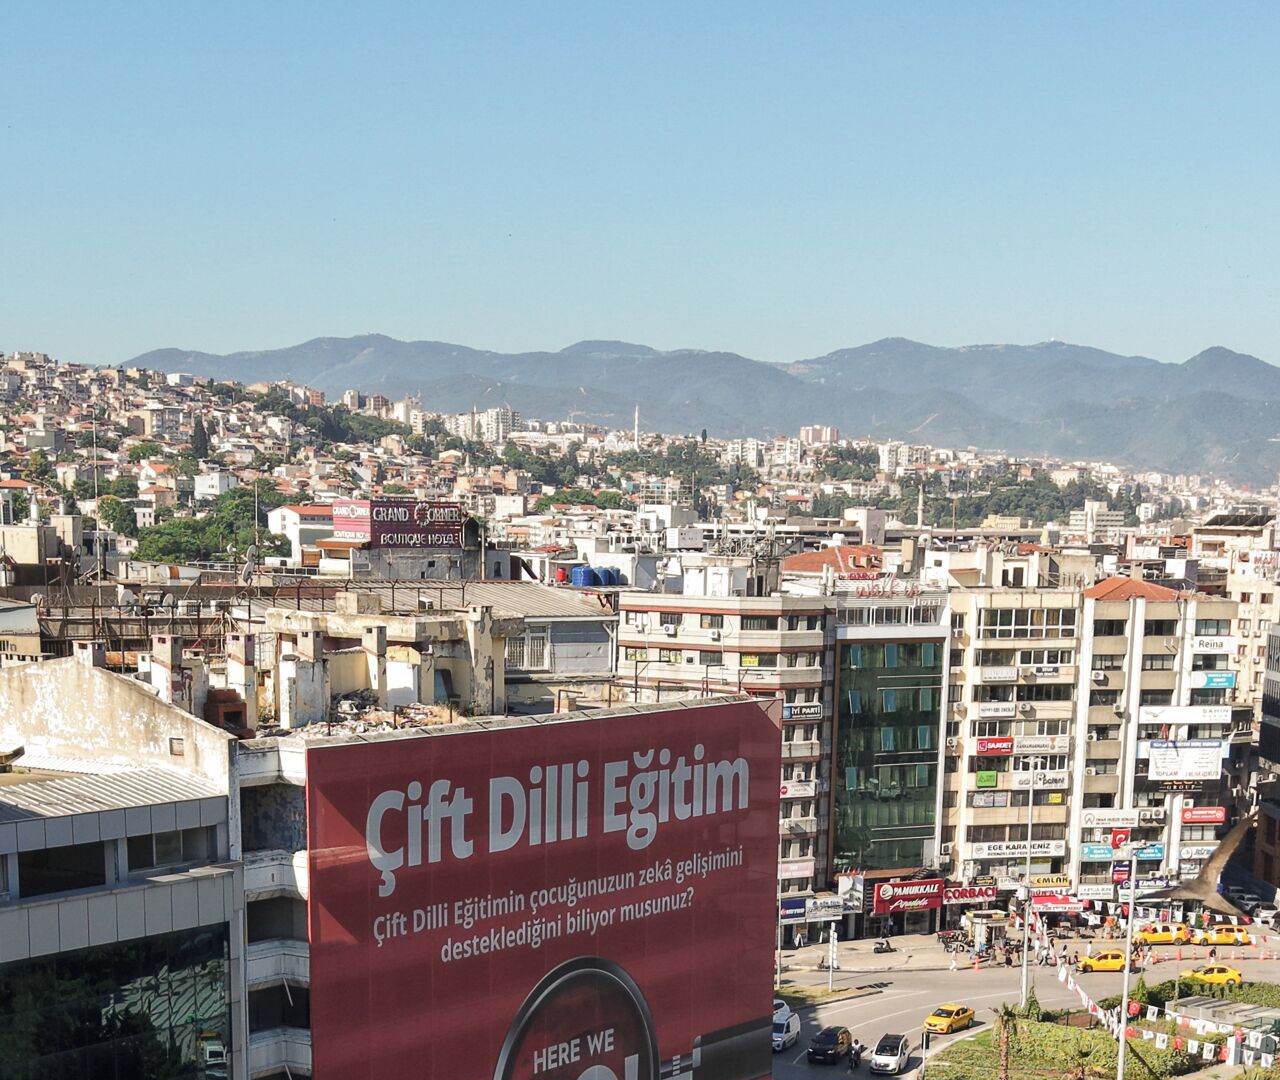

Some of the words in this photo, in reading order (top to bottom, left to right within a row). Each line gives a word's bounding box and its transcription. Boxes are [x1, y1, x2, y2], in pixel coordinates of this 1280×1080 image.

[373, 507, 409, 521] GRAND
[381, 533, 426, 546] BOUTIQUE
[1198, 639, 1224, 649] Reina
[791, 704, 800, 715] İYİ
[801, 704, 821, 715] PARTİ
[987, 741, 1013, 750] SAADET
[365, 779, 475, 897] Çift
[489, 758, 589, 854] Dilli
[603, 743, 750, 851] Eğitim
[373, 913, 407, 948] Çift
[413, 905, 449, 934] Dilli
[454, 892, 525, 930] Eğitimin
[530, 872, 635, 913] çocuğunuzun
[639, 859, 673, 887] zekâ
[676, 846, 744, 878] gelişimini
[893, 884, 940, 896] PAMUKKALE
[943, 887, 997, 903] ÇORBACI
[440, 914, 562, 963] desteklediğini
[566, 902, 616, 941] biliyor
[620, 889, 695, 925] musunuz?
[533, 1036, 581, 1074] HERE
[587, 1028, 615, 1055] WE
